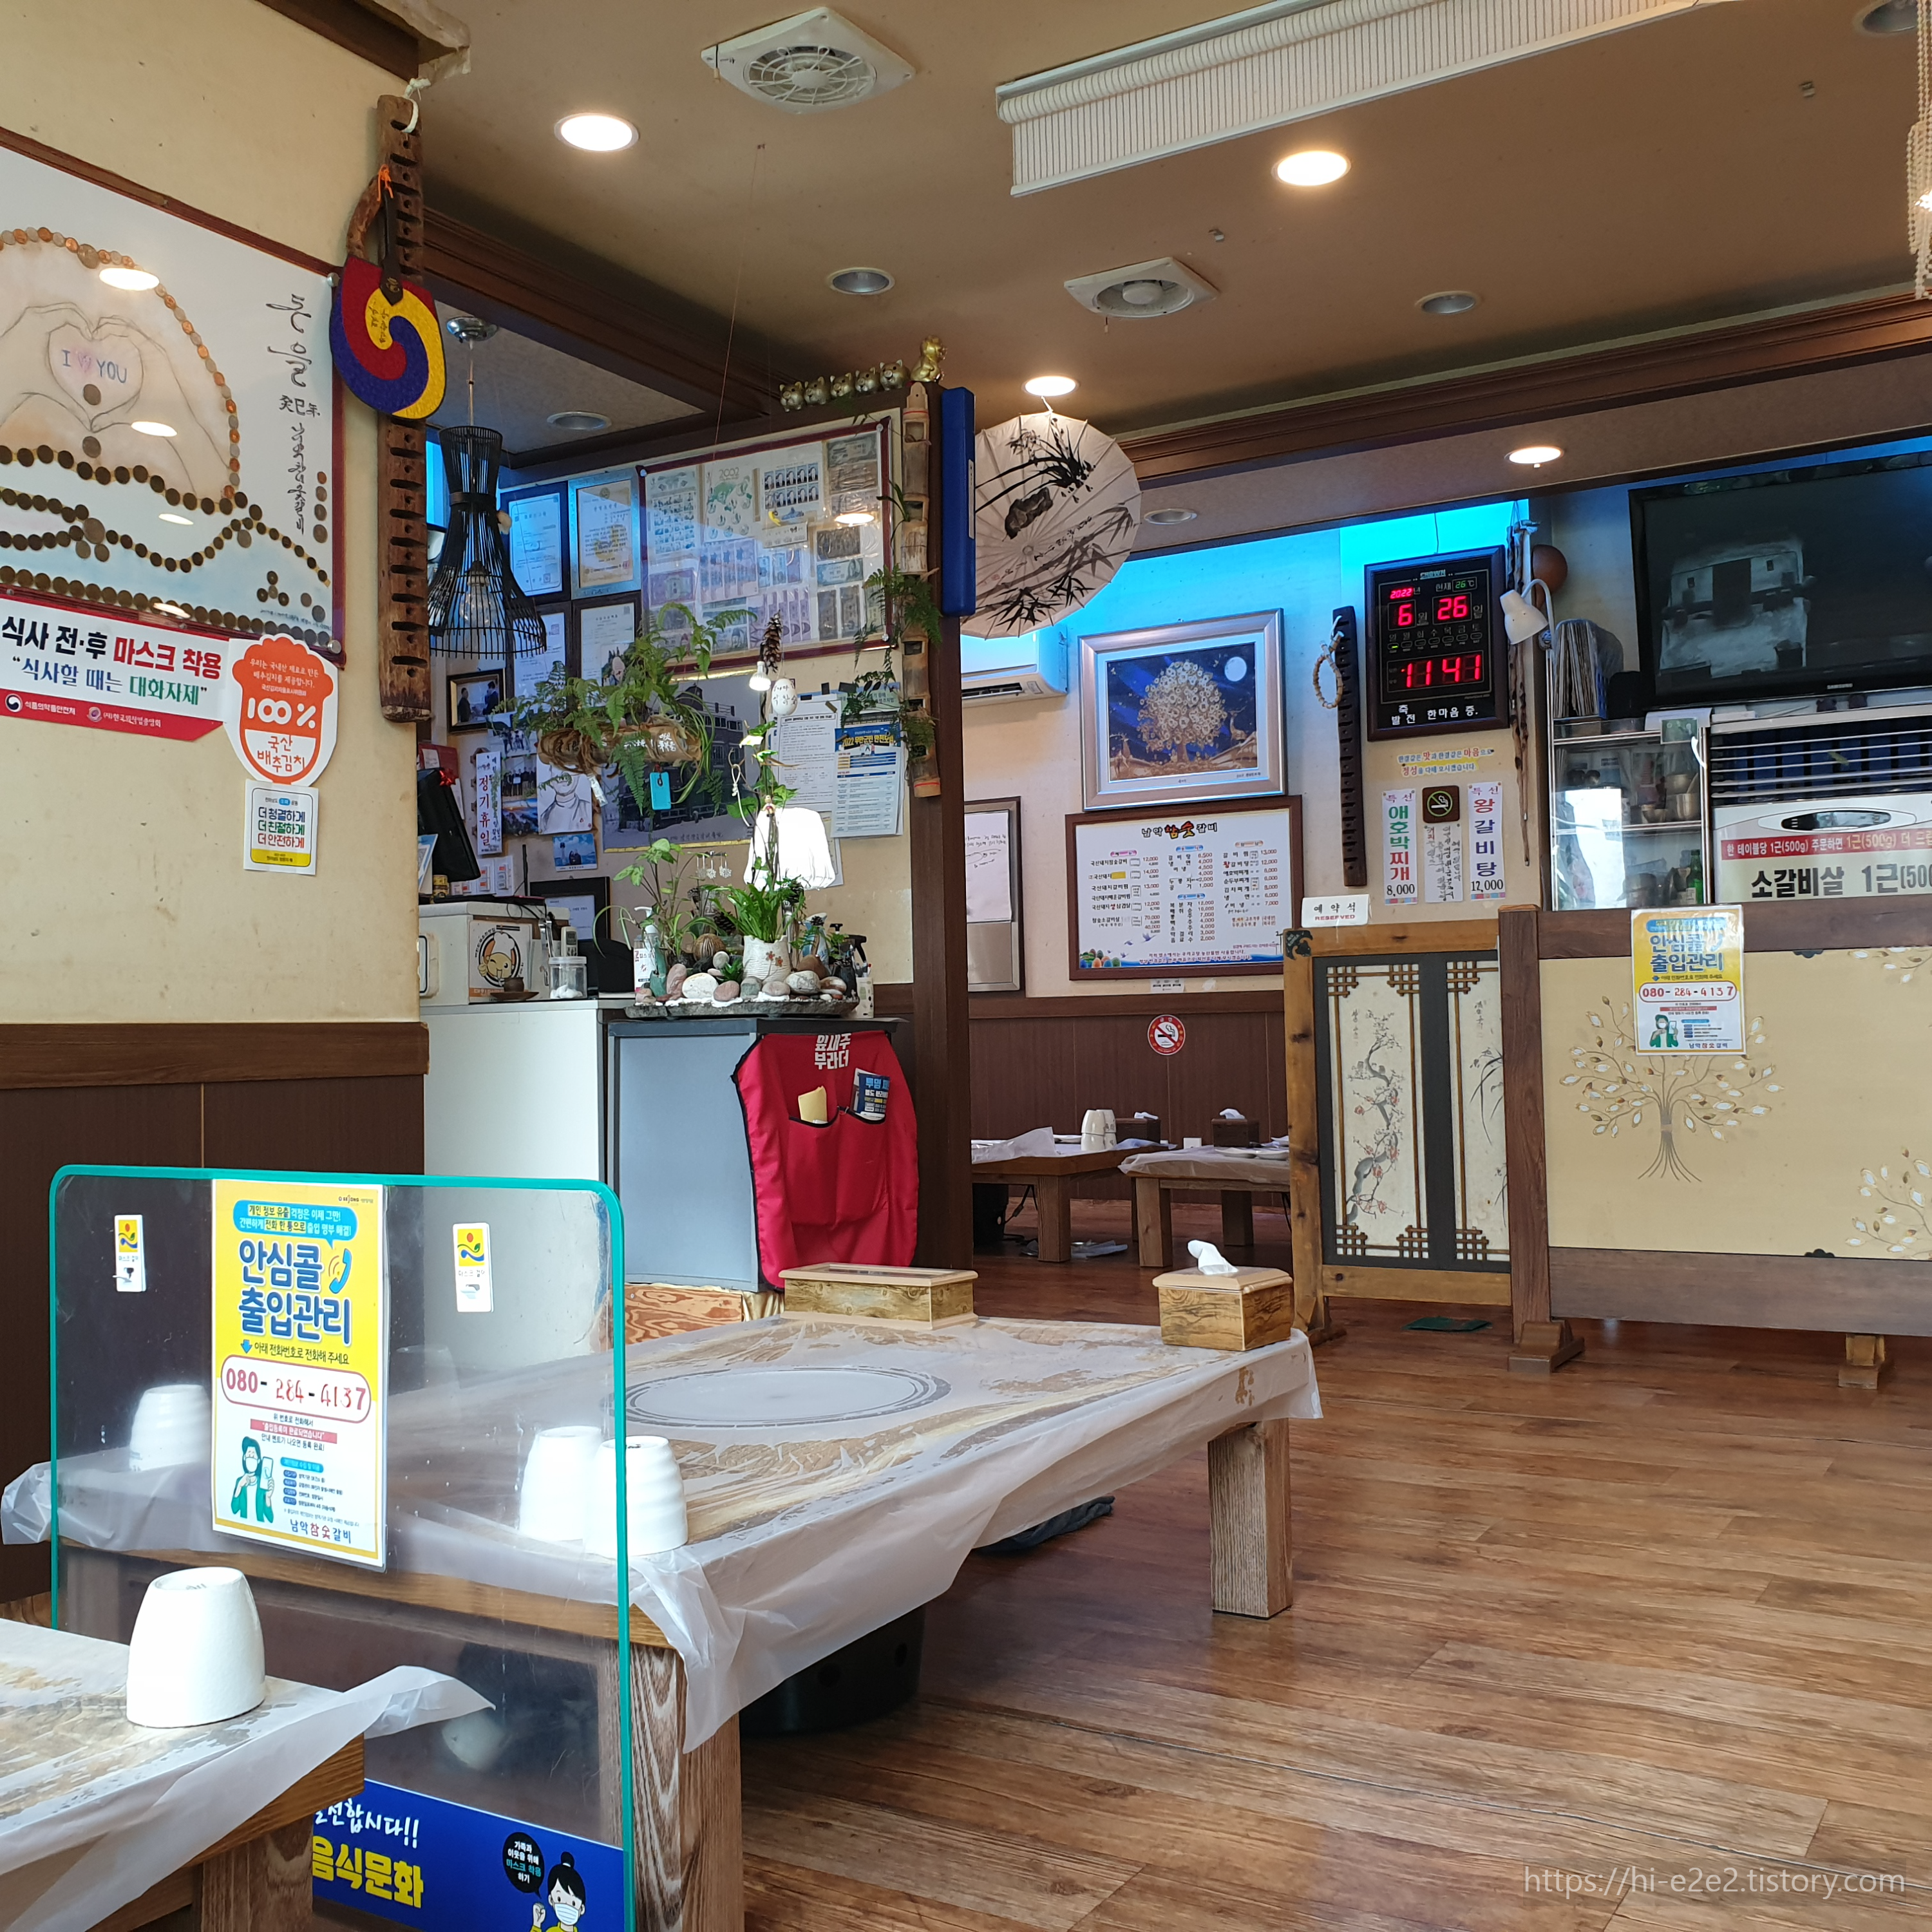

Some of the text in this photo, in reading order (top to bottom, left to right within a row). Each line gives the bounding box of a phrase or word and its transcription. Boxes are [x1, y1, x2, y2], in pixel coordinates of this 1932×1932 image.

[62, 350, 127, 383] I YOU
[1390, 587, 1413, 599] 2022
[1397, 596, 1482, 626] 6 월 26 일
[2, 616, 222, 679] 식사 전·후 마스크 착용
[250, 659, 318, 677] 우리는 국내산 재료로 만든
[86, 668, 122, 693] 때는
[254, 672, 315, 688] 배추김치를 제공합니다.
[25, 701, 75, 715] 식품의약품안전처
[247, 697, 316, 728] 100%
[1399, 705, 1408, 714] 축
[1427, 707, 1459, 720] 한마음
[269, 736, 292, 753] 국산
[258, 750, 305, 772] 배추김치
[1423, 752, 1437, 761] 맛과
[1464, 748, 1492, 757] 마음으로
[1403, 766, 1423, 776] 정성을
[1439, 763, 1475, 772] 모시겠습니다.
[1386, 793, 1412, 802] 특선
[1472, 786, 1499, 795] 특선
[259, 807, 305, 822] 더 청결하게
[478, 775, 490, 846] 정기휴일
[258, 820, 305, 835] 더 친절하게
[258, 833, 304, 848] 더 안전하게
[1388, 806, 1410, 881] 애호박찌개
[1473, 799, 1497, 876] 왕갈비탕
[1727, 844, 1734, 857] 한
[1738, 842, 1767, 855] 테이블당
[1771, 841, 1808, 853] 1근(500g)
[1812, 837, 1842, 851] 주문하면
[1846, 833, 1896, 849] 1근(500g)
[1901, 833, 1911, 845] 더
[1387, 884, 1415, 896] 8,000
[1471, 879, 1504, 893] 12,000
[1752, 866, 1844, 898] 소갈비살
[1314, 902, 1355, 914] 예약석
[1650, 934, 1705, 952] 안심콜
[1651, 953, 1723, 972] 출입관리
[815, 1033, 851, 1052] 잎새주
[815, 1050, 849, 1070] 부라더
[249, 1205, 341, 1222] 개인 정보 유출 걱정은 이제 그만!
[240, 1217, 351, 1236] 간편하게 전화 한 통으로 출입 명부 해결!
[239, 1240, 323, 1291] 안심콜
[238, 1287, 350, 1345] 출입관리
[254, 1341, 349, 1365] 아래 전화번호로 전화해 주세요
[279, 1414, 292, 1423] 번호로
[295, 1417, 313, 1426] 전화해서
[261, 1434, 270, 1442] 안내
[272, 1435, 286, 1444] 멘트가
[287, 1438, 301, 1447] 나오면
[515, 1841, 532, 1853] 가족과
[507, 1848, 538, 1865] 이웃을 위해
[312, 1835, 424, 1908] 음식문화
[506, 1859, 541, 1877] 마스크 착용
[518, 1872, 529, 1884] 하기
